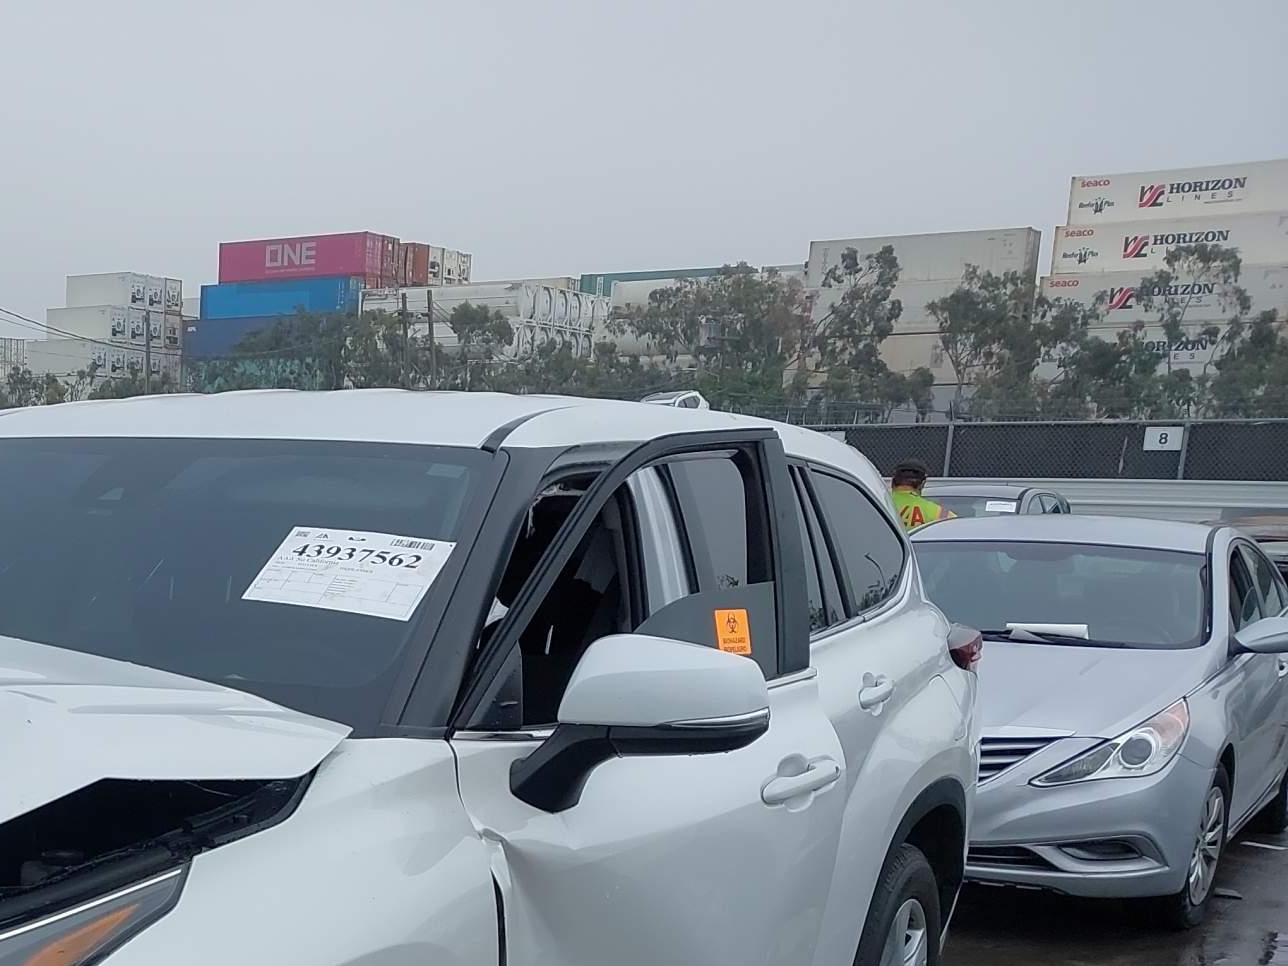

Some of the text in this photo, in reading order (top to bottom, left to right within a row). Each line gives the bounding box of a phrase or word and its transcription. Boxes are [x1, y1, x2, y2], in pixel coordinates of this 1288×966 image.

[1080, 178, 1111, 188] seaco
[1168, 177, 1248, 194] HORIZON
[1064, 228, 1094, 238] seaco
[1152, 230, 1231, 246] HORIZON
[265, 241, 317, 267] ONE
[1049, 279, 1079, 288] seaco
[1142, 283, 1217, 297] ORIZON
[1159, 432, 1168, 445] 8
[292, 543, 422, 569] 43937562
